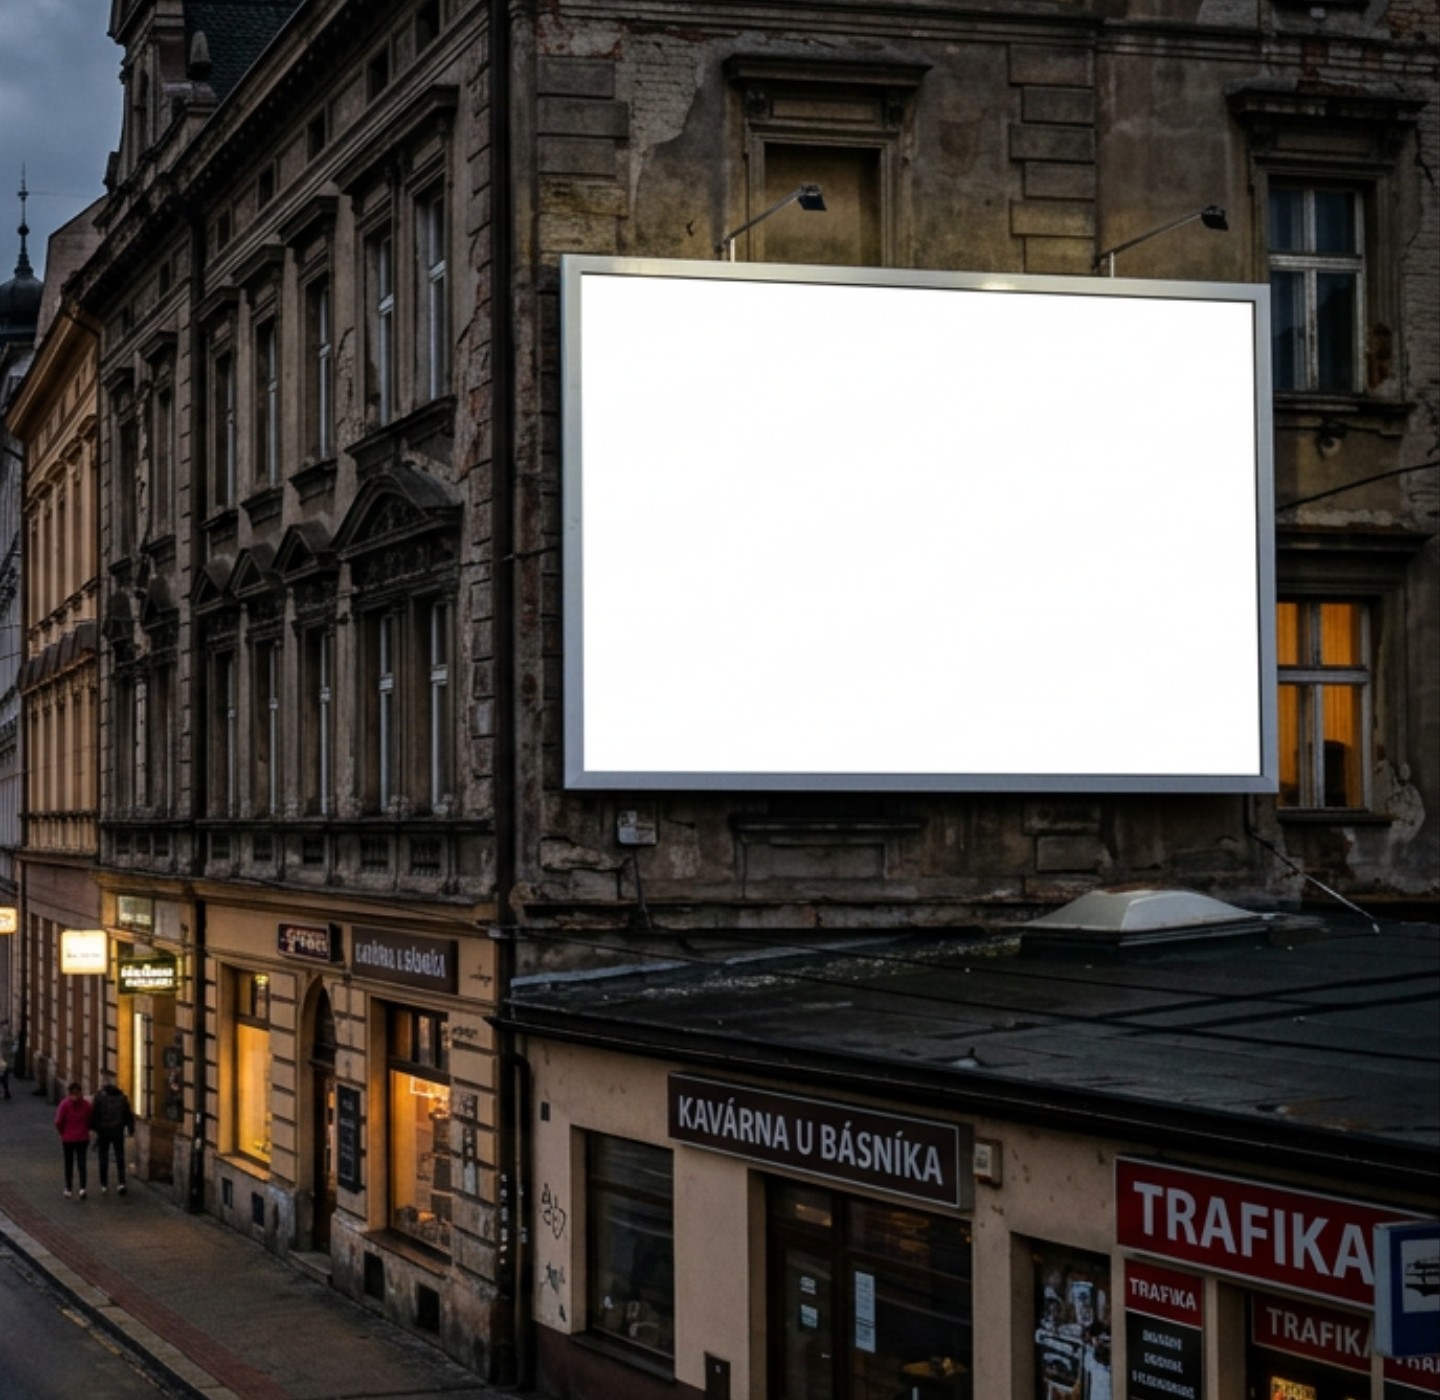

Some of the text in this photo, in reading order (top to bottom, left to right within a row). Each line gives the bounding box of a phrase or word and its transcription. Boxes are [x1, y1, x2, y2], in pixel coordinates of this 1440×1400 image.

[678, 1094, 944, 1186] KAVÁRNA U BÁSNÍKA
[1132, 1180, 1374, 1286] TRAFIKA
